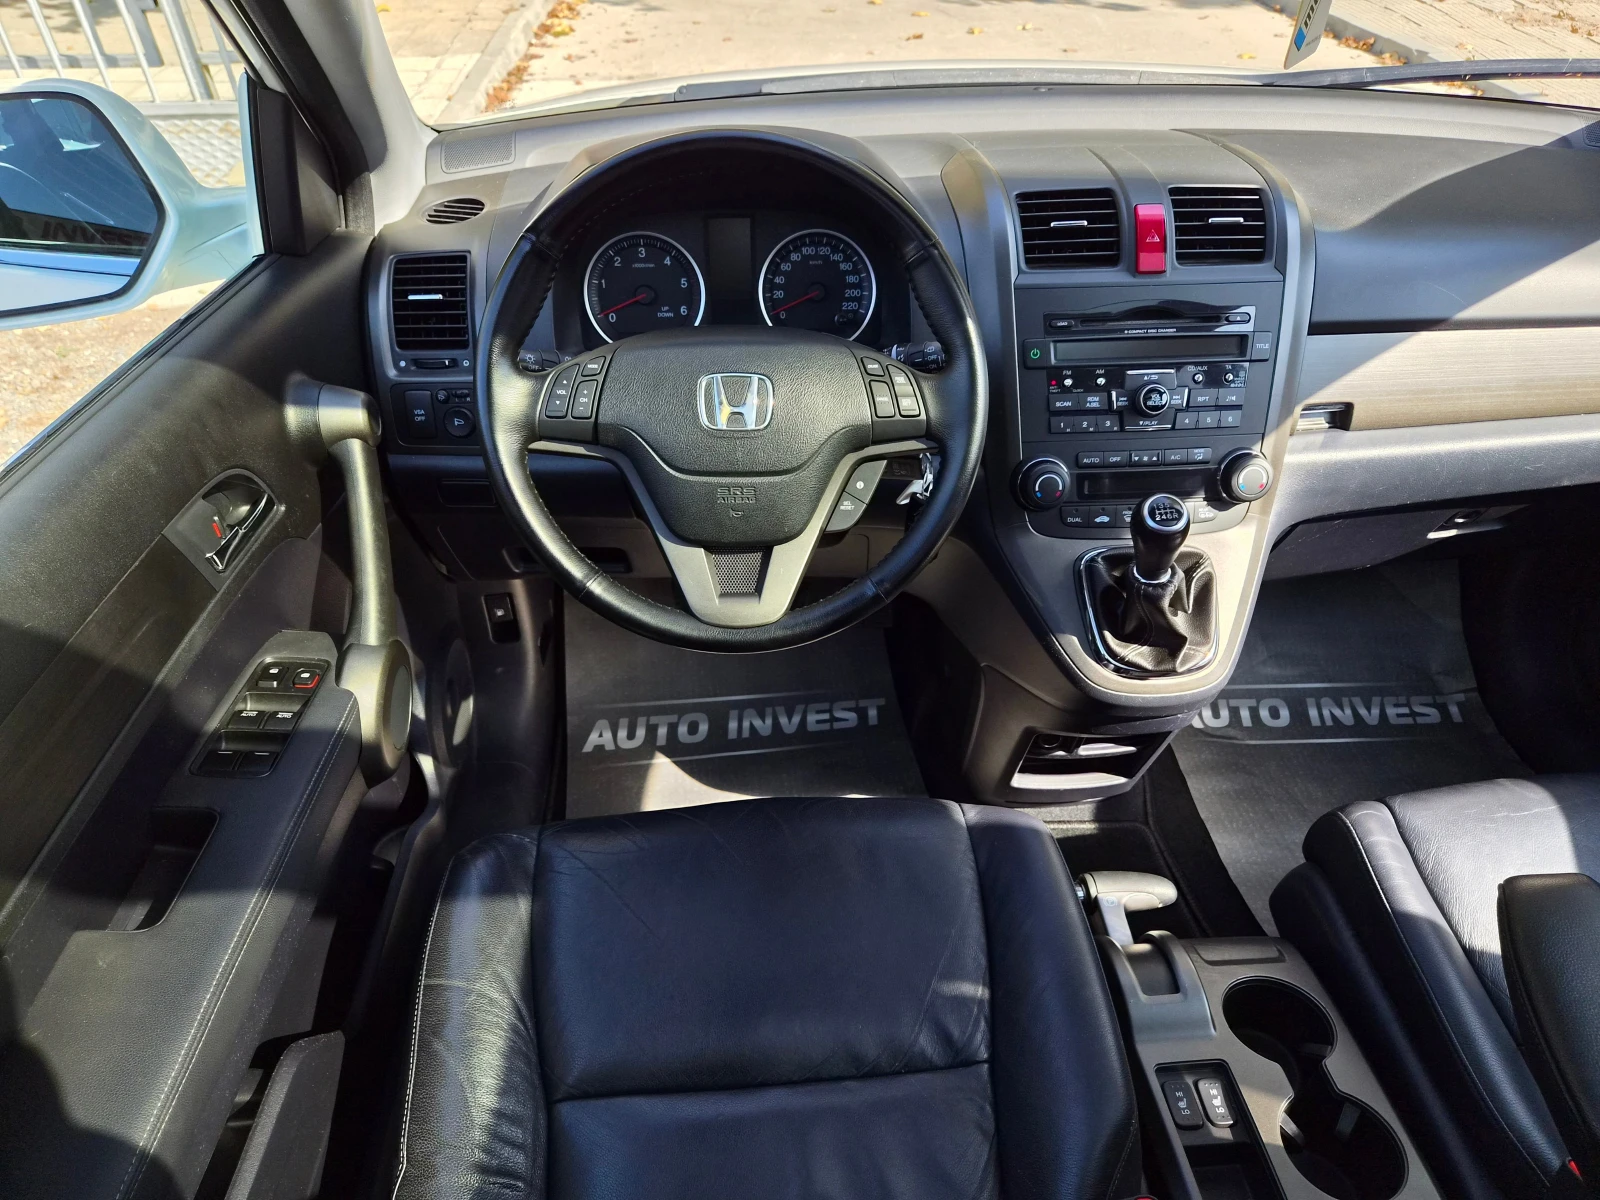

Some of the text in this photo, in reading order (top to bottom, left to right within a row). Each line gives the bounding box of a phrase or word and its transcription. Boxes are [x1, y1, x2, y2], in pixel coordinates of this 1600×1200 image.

[639, 248, 645, 257] 3
[614, 257, 621, 266] 2
[664, 256, 671, 265] 4
[602, 279, 605, 288] 1
[681, 278, 687, 288] 5
[681, 306, 687, 315] 6
[609, 313, 616, 322] 0
[718, 487, 756, 495] SRS
[1307, 693, 1466, 727] INVEST
[582, 698, 886, 753] AUTO INVEST
